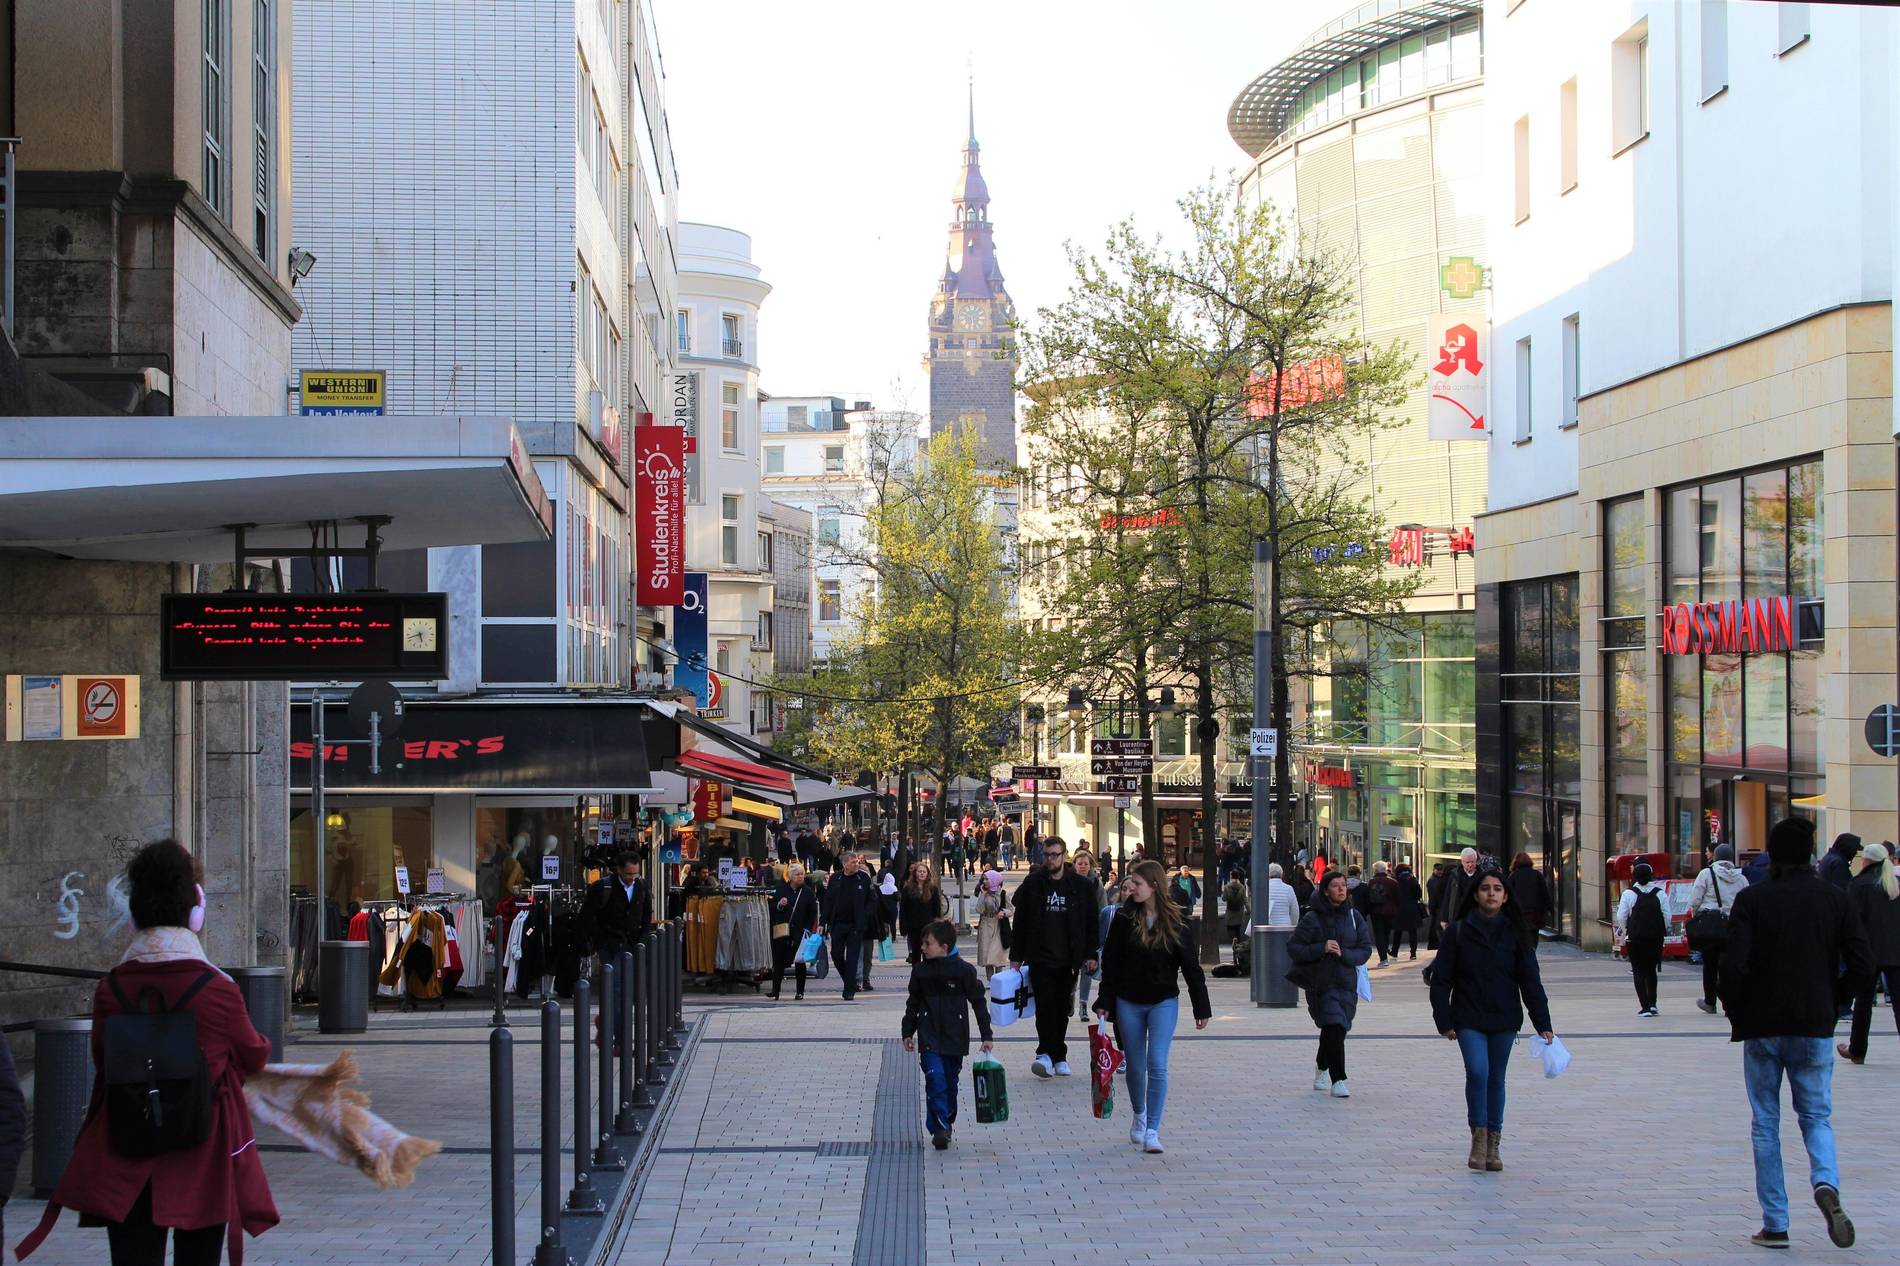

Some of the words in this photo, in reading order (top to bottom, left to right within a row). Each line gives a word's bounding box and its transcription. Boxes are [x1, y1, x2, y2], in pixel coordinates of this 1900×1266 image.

[671, 498, 680, 513] für
[651, 469, 670, 590] Studienkreis
[671, 514, 680, 574] Profi-Nachhilfe
[1663, 595, 1793, 656] ROSSMANN
[290, 735, 505, 761] SISER'S
[1251, 731, 1277, 744] Polizei
[1163, 775, 1202, 786] HUSSE
[706, 780, 719, 818] BISS
